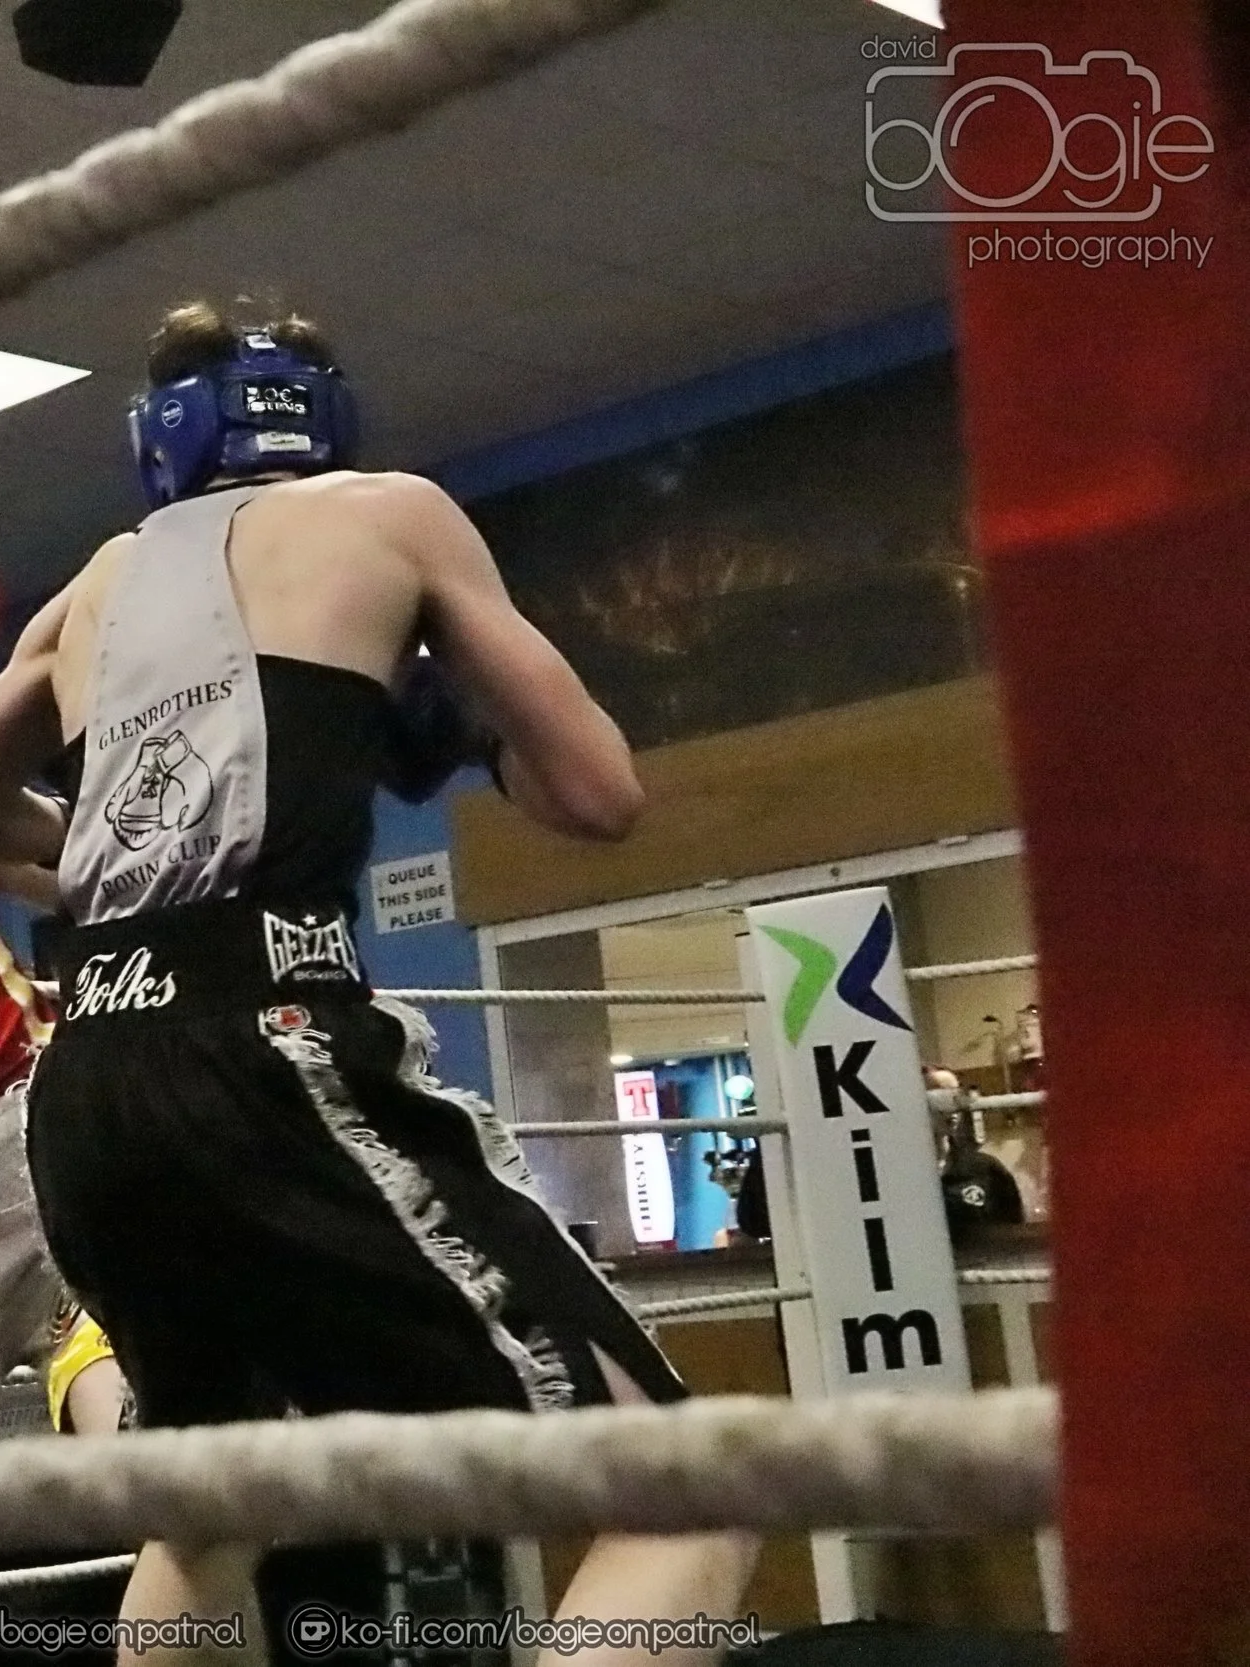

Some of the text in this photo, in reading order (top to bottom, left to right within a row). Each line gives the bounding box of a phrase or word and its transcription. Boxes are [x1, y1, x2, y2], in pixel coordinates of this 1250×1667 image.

[99, 680, 233, 750] GLENROTHES
[388, 864, 437, 885] QUEUE
[377, 884, 447, 909] THIS SIDE
[390, 907, 444, 929] PLEASE
[622, 1078, 654, 1117] T
